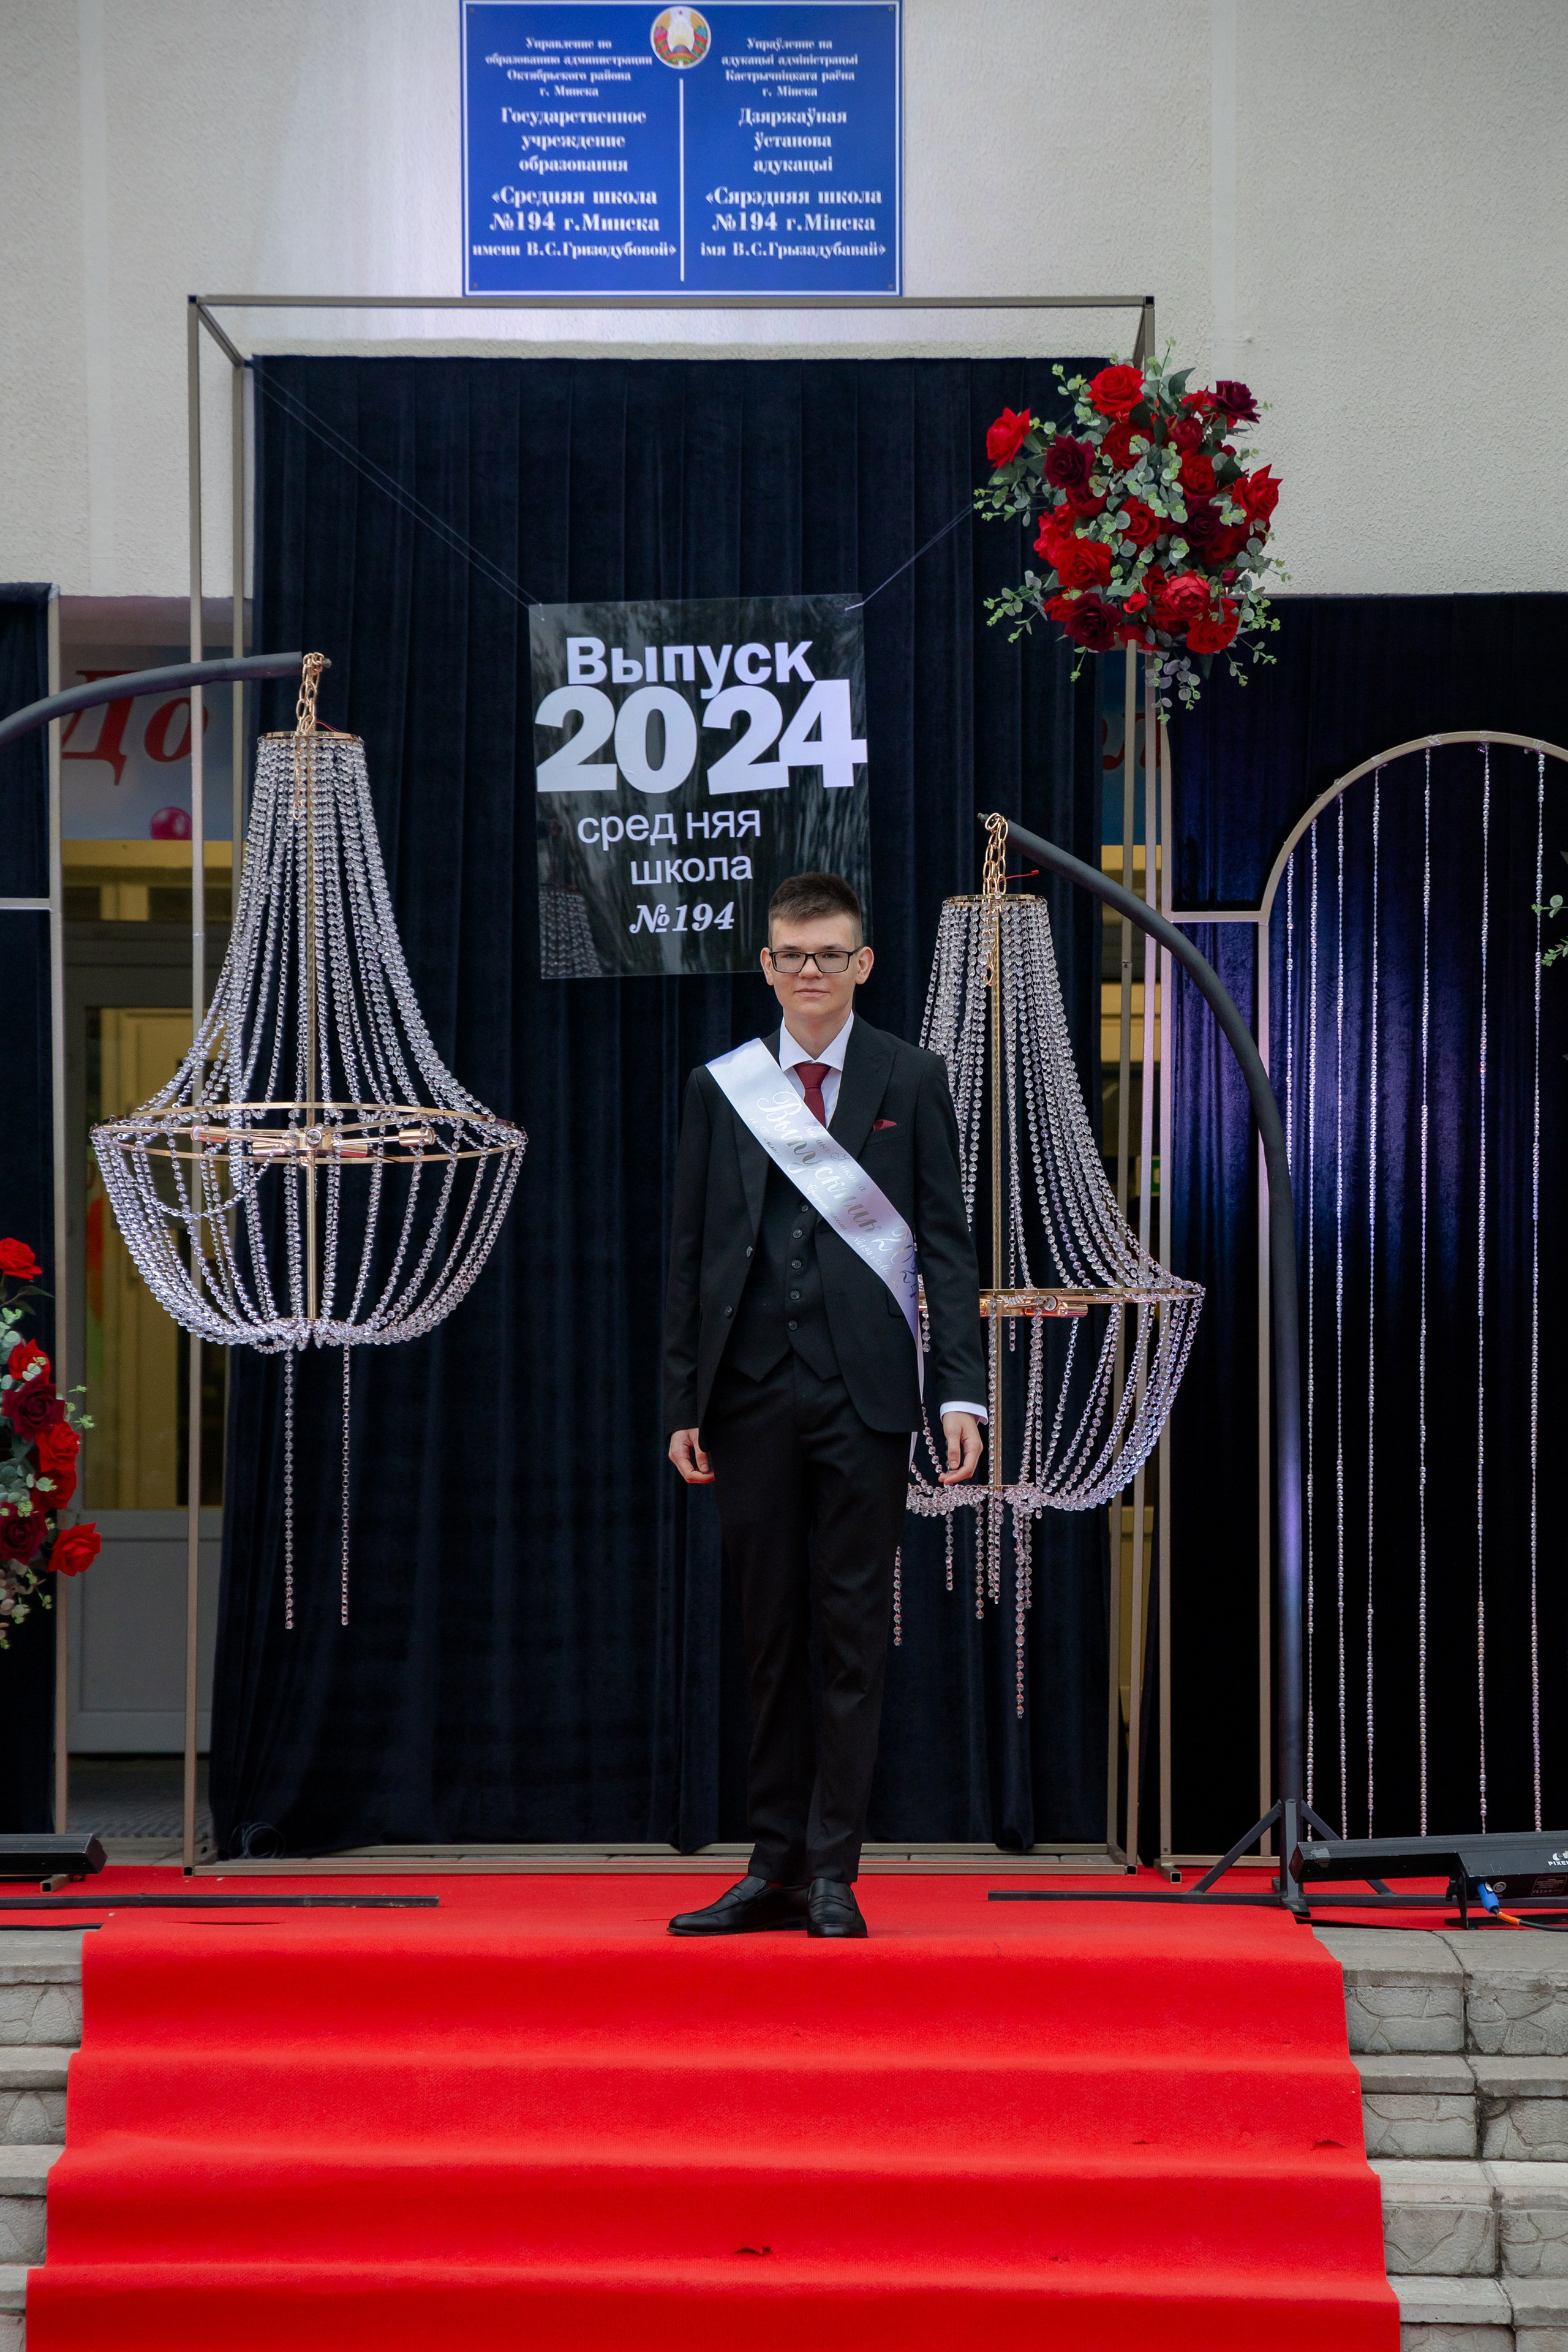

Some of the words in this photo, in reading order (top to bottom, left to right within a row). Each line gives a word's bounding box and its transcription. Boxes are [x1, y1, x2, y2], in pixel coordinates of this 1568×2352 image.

[526, 37, 594, 51] Управление
[598, 40, 612, 49] по
[818, 40, 832, 49] па
[485, 53, 560, 67] образованию
[563, 56, 652, 67] администрации
[722, 54, 774, 67] адукацыі
[778, 54, 858, 67] адміністрацыі
[507, 69, 587, 83] Октябрьского
[590, 70, 631, 83] района
[725, 70, 818, 83] Кастрычніцкага
[821, 70, 855, 83] раёна
[540, 88, 549, 97] г.
[554, 85, 599, 97] Минска
[762, 88, 772, 97] г.
[777, 86, 818, 97] Мінска
[501, 107, 647, 127] Государственное
[738, 107, 847, 127] Дзяржаўная
[521, 135, 625, 151] учреждение
[754, 132, 832, 151] ўстанова
[518, 155, 628, 175] образования
[753, 156, 833, 175] адукацыі
[492, 186, 585, 208] «Средняя
[592, 190, 657, 205] школа
[705, 186, 810, 209] «Сярэдняя
[818, 190, 882, 204] школа
[489, 211, 556, 231] №194
[564, 213, 660, 232] г.Минска
[712, 211, 778, 232] №194
[786, 213, 876, 231] г.Мінска
[472, 244, 521, 256] имени
[527, 241, 677, 260] В.С.Гризодубовой»
[701, 241, 726, 256] імя
[733, 241, 886, 260] В.С.Грызадубавай»
[566, 636, 816, 699] Выпуск
[535, 679, 868, 795] 2024
[630, 854, 753, 886] школа
[628, 901, 735, 933] №194
[756, 1091, 882, 1237] Выпускник
